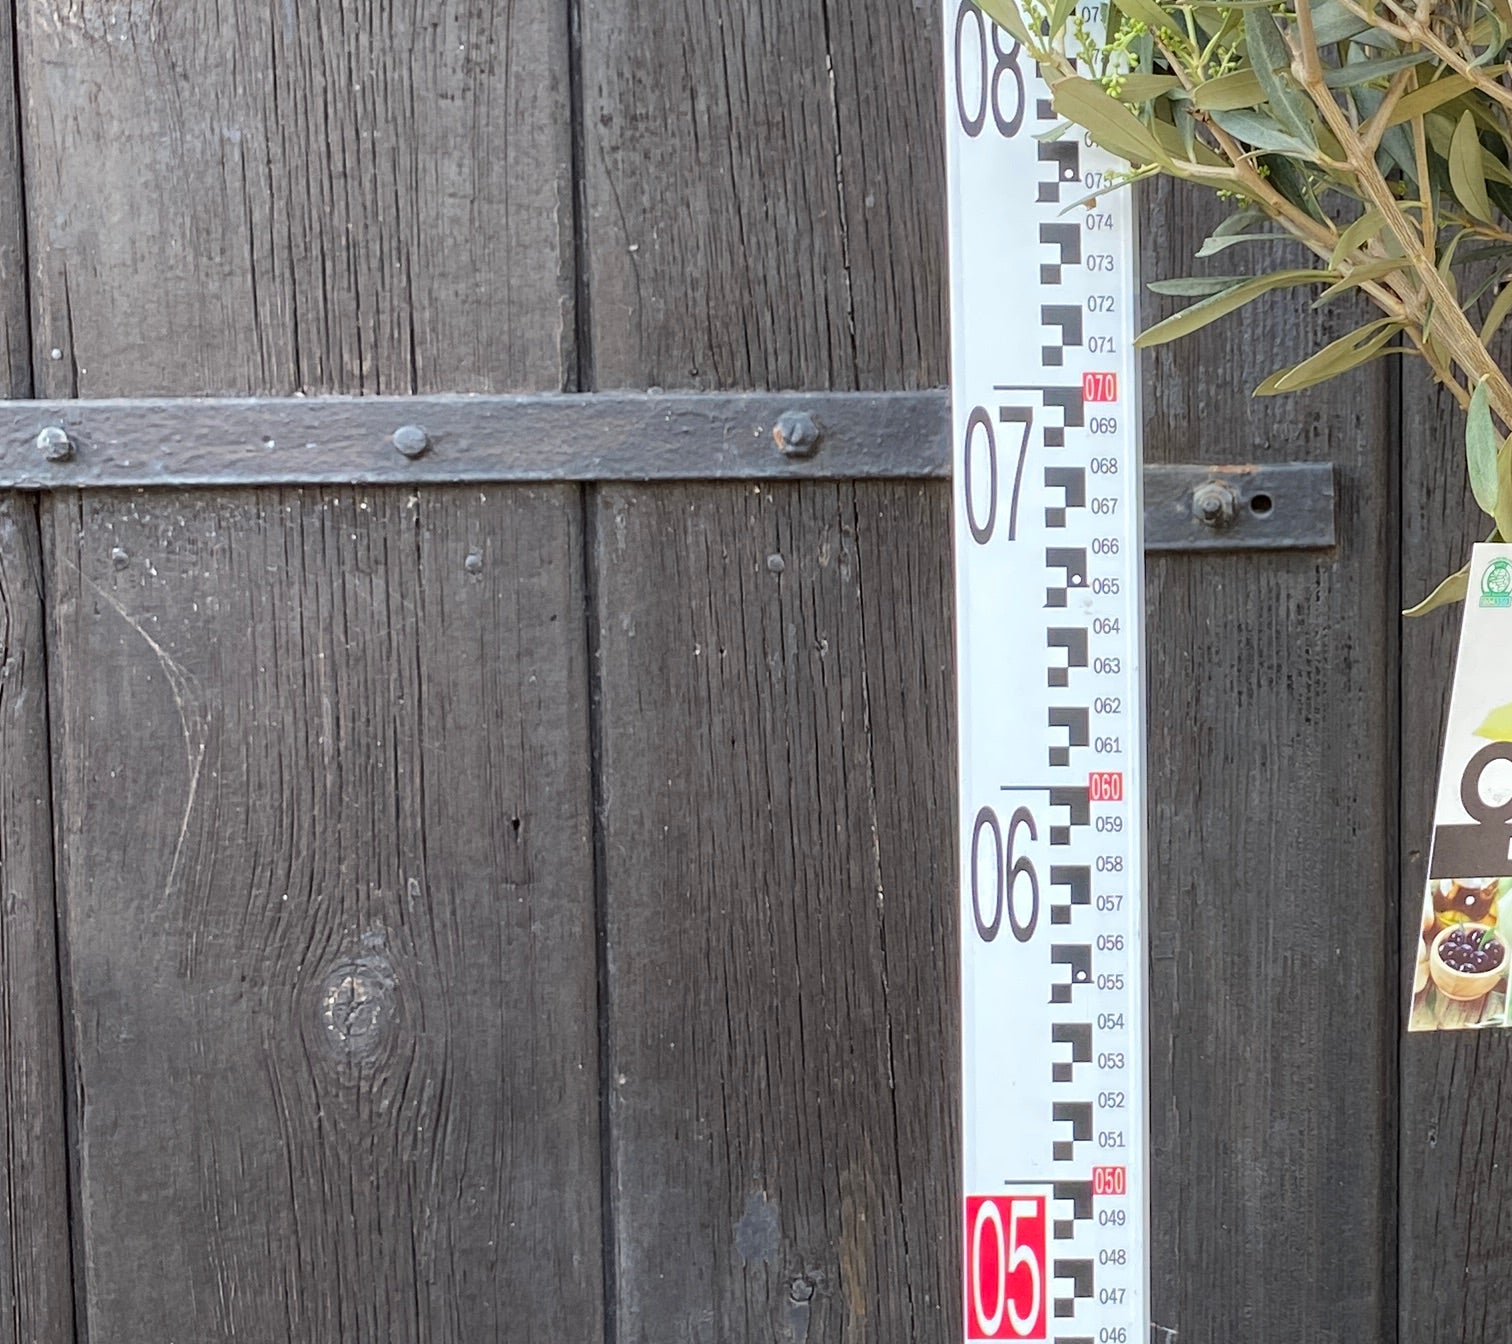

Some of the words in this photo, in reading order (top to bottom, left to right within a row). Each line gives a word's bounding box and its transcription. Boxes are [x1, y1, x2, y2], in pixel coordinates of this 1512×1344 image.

[1084, 171, 1113, 190] 075
[1085, 213, 1114, 231] 074
[1086, 254, 1115, 272] 073
[1087, 295, 1115, 313] 072
[1087, 335, 1117, 354] 071
[1085, 374, 1116, 401] 070
[1089, 416, 1118, 435] 069
[1090, 457, 1119, 475] 068
[964, 406, 1033, 545] 07
[1090, 497, 1119, 515] 067
[1091, 537, 1120, 555] 066
[1091, 577, 1120, 595] 065
[1092, 617, 1121, 635] 064
[1093, 657, 1121, 675] 063
[1093, 696, 1122, 715] 062
[1094, 736, 1123, 754] 061
[1090, 774, 1121, 800] 060
[1095, 815, 1123, 833] 059
[1095, 855, 1124, 873] 058
[971, 806, 1039, 942] 06
[1096, 894, 1124, 912] 057
[1096, 934, 1125, 952] 056
[1096, 973, 1125, 991] 055
[1096, 1012, 1125, 1031] 054
[1097, 1052, 1125, 1070] 053
[1097, 1091, 1125, 1109] 052
[1098, 1130, 1126, 1149] 051
[1094, 1168, 1125, 1194] 050
[1098, 1209, 1126, 1227] 049
[1098, 1248, 1127, 1266] 048
[972, 1200, 1040, 1336] 05
[1098, 1287, 1127, 1306] 047
[1099, 1326, 1127, 1344] 046
